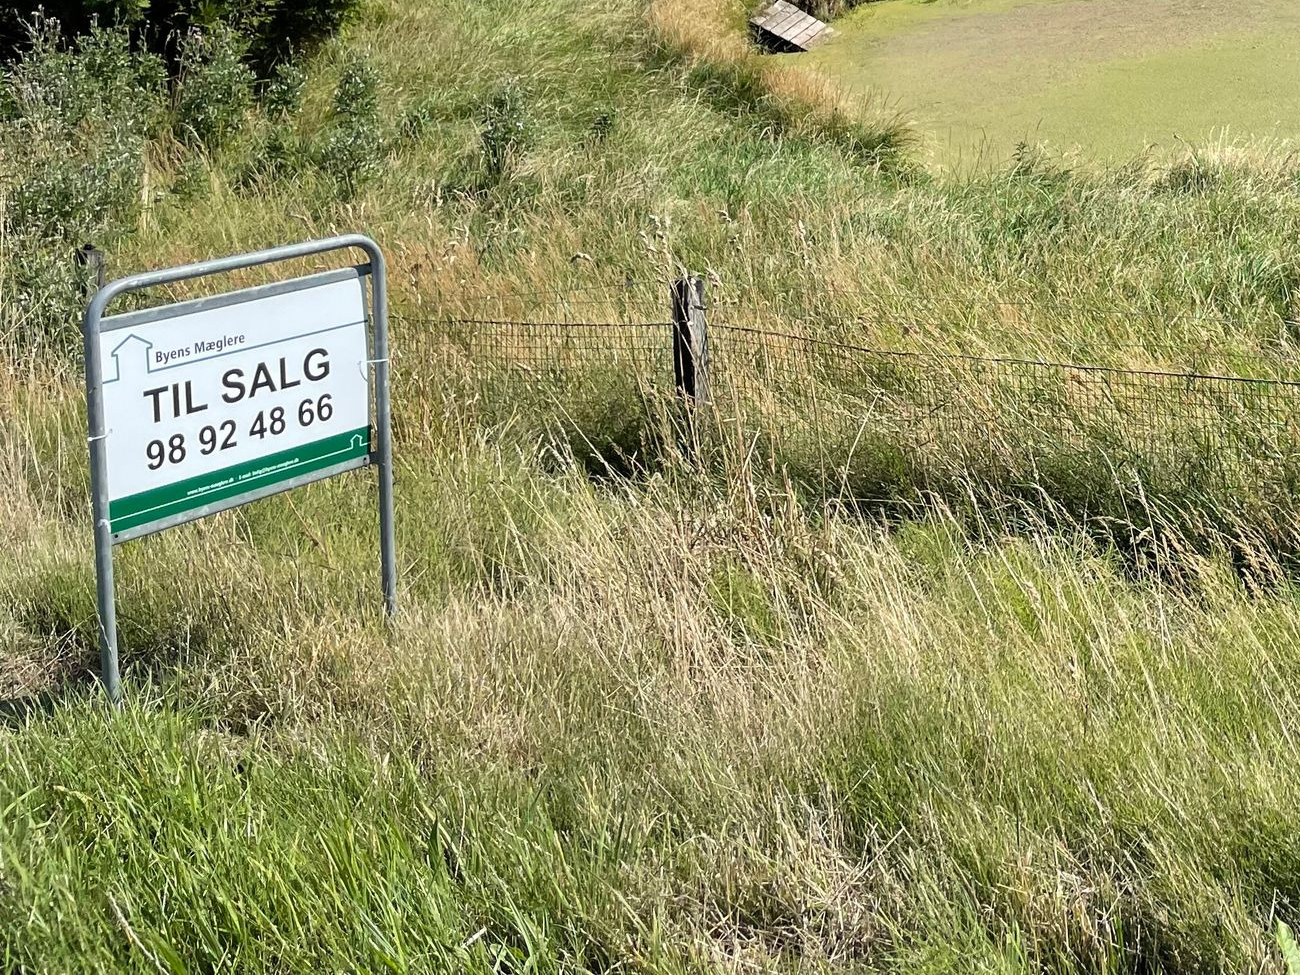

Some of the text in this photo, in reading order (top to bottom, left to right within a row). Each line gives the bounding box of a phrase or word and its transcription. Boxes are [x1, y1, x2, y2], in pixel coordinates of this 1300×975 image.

[144, 348, 330, 424] TIL SALG
[155, 333, 245, 365] Byens Mæglere
[146, 393, 333, 471] 98 92 48 66
